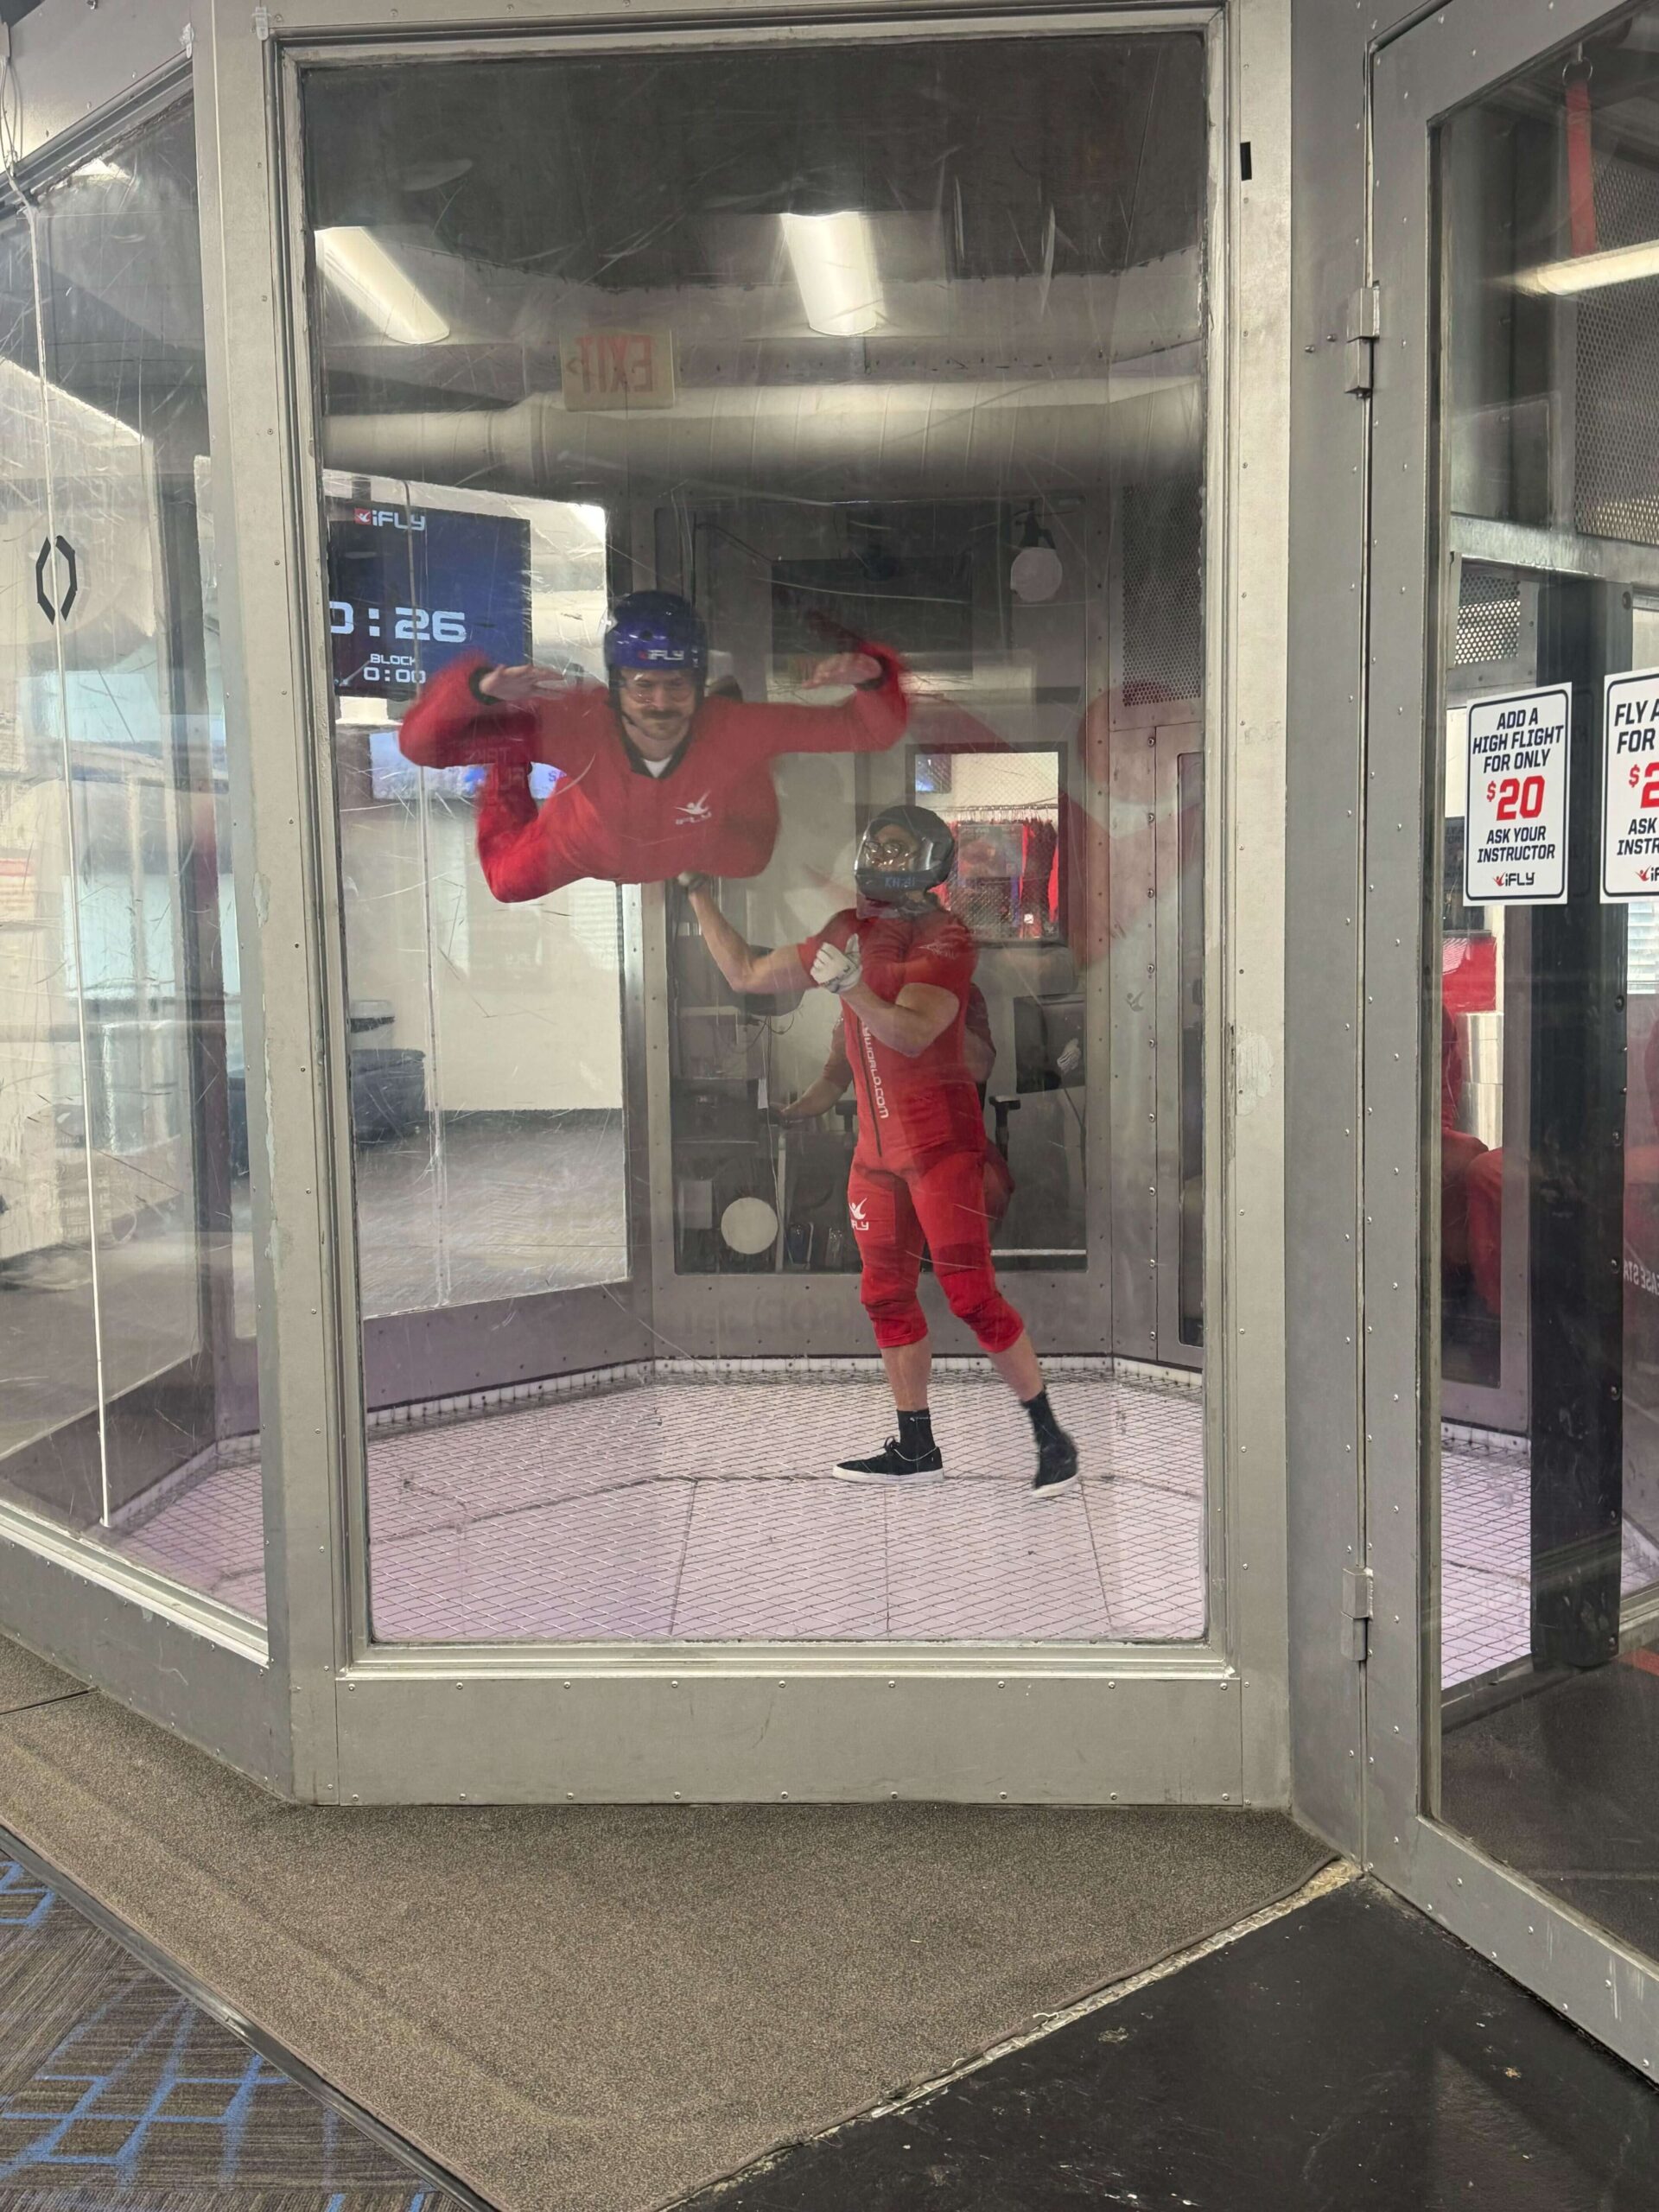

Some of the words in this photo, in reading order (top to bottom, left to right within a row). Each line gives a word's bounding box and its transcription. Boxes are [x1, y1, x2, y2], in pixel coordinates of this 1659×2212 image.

[372, 510, 426, 531] iFLY
[329, 601, 467, 643] 0:26
[363, 666, 427, 684] 0:00
[1497, 709, 1525, 730] ADD
[1529, 708, 1539, 726] A
[1614, 700, 1649, 727] FLY
[1472, 734, 1508, 754] HIGH
[1511, 725, 1564, 749] FLIGHT
[1617, 728, 1656, 754] FOR
[1484, 755, 1510, 773] FOR
[1514, 748, 1550, 769] ONLY
[1486, 775, 1545, 821] $20
[1486, 829, 1511, 844] ASK
[1514, 825, 1547, 842] YOUR
[1628, 817, 1657, 836] ASK
[1477, 844, 1555, 863] INSTRUCTOR
[1617, 837, 1659, 855] INSTR
[1504, 872, 1535, 887] iFLY
